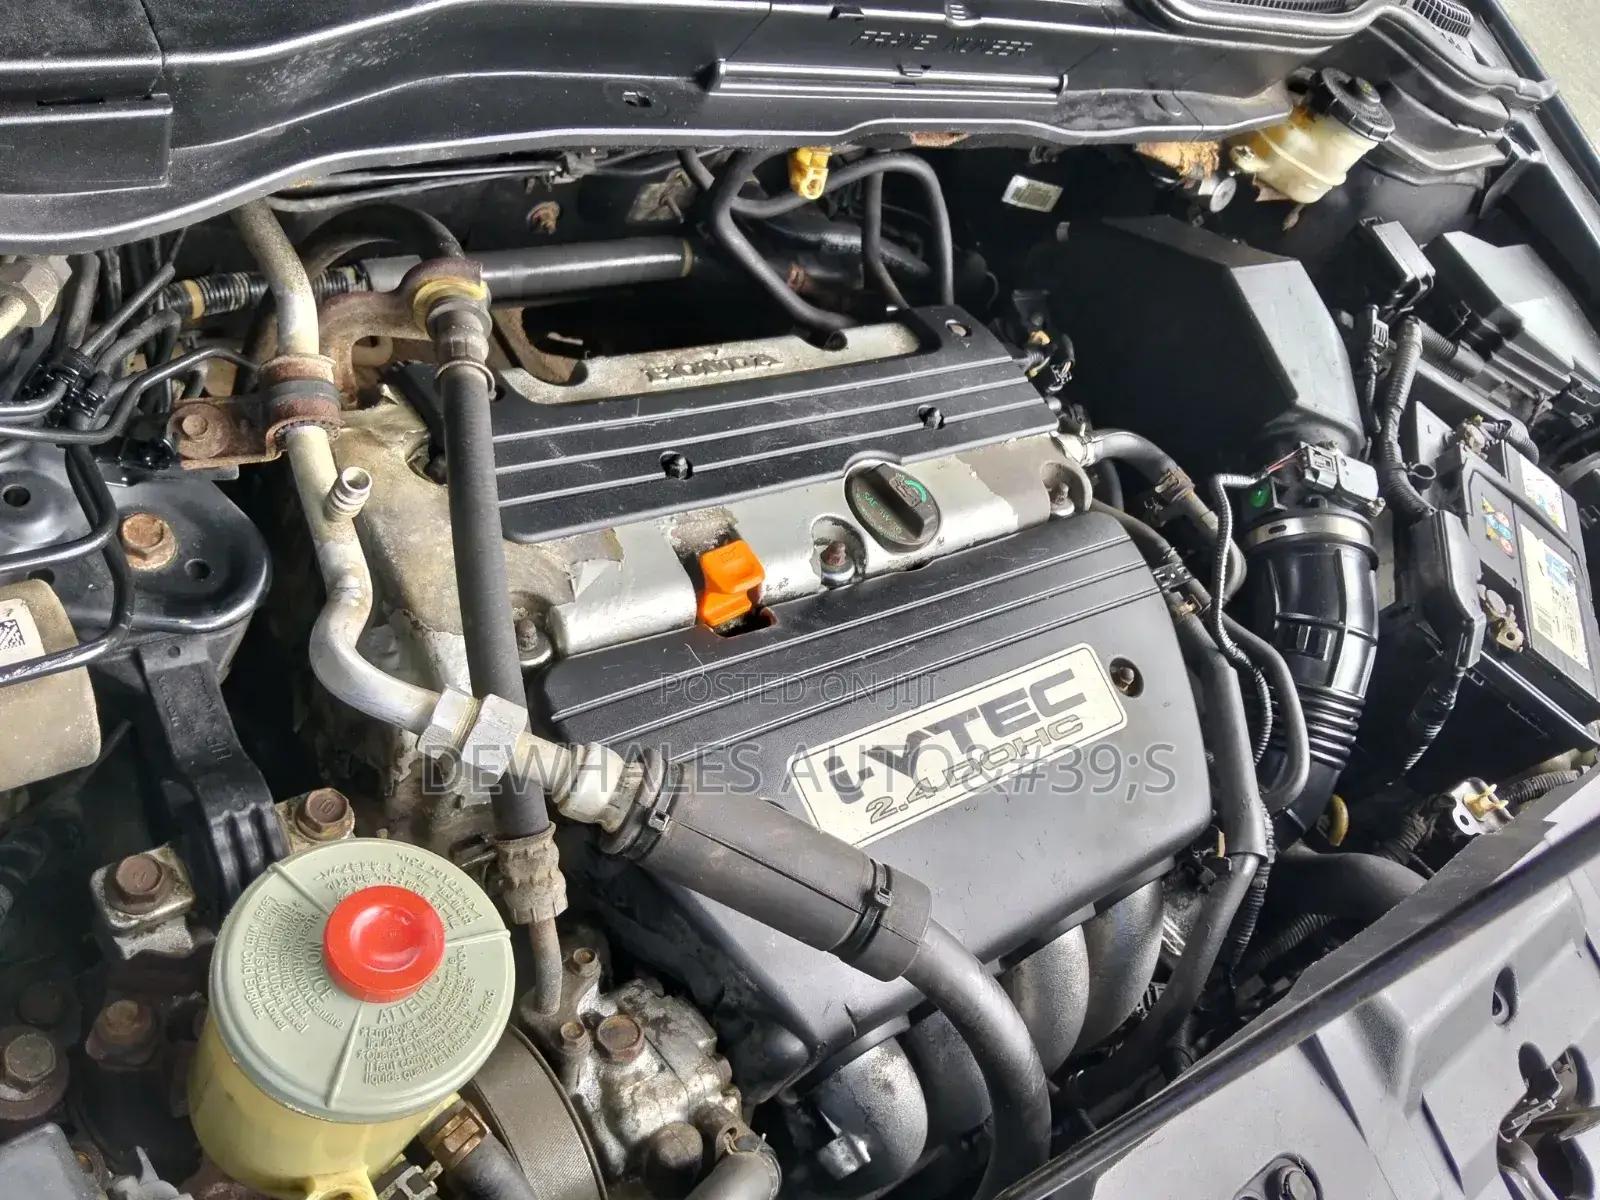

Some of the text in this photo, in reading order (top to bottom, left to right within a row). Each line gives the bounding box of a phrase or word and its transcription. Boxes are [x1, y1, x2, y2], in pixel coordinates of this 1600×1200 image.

[642, 353, 783, 383] HONDA
[865, 777, 939, 825] 2.4
[307, 938, 336, 1005] NOTICE
